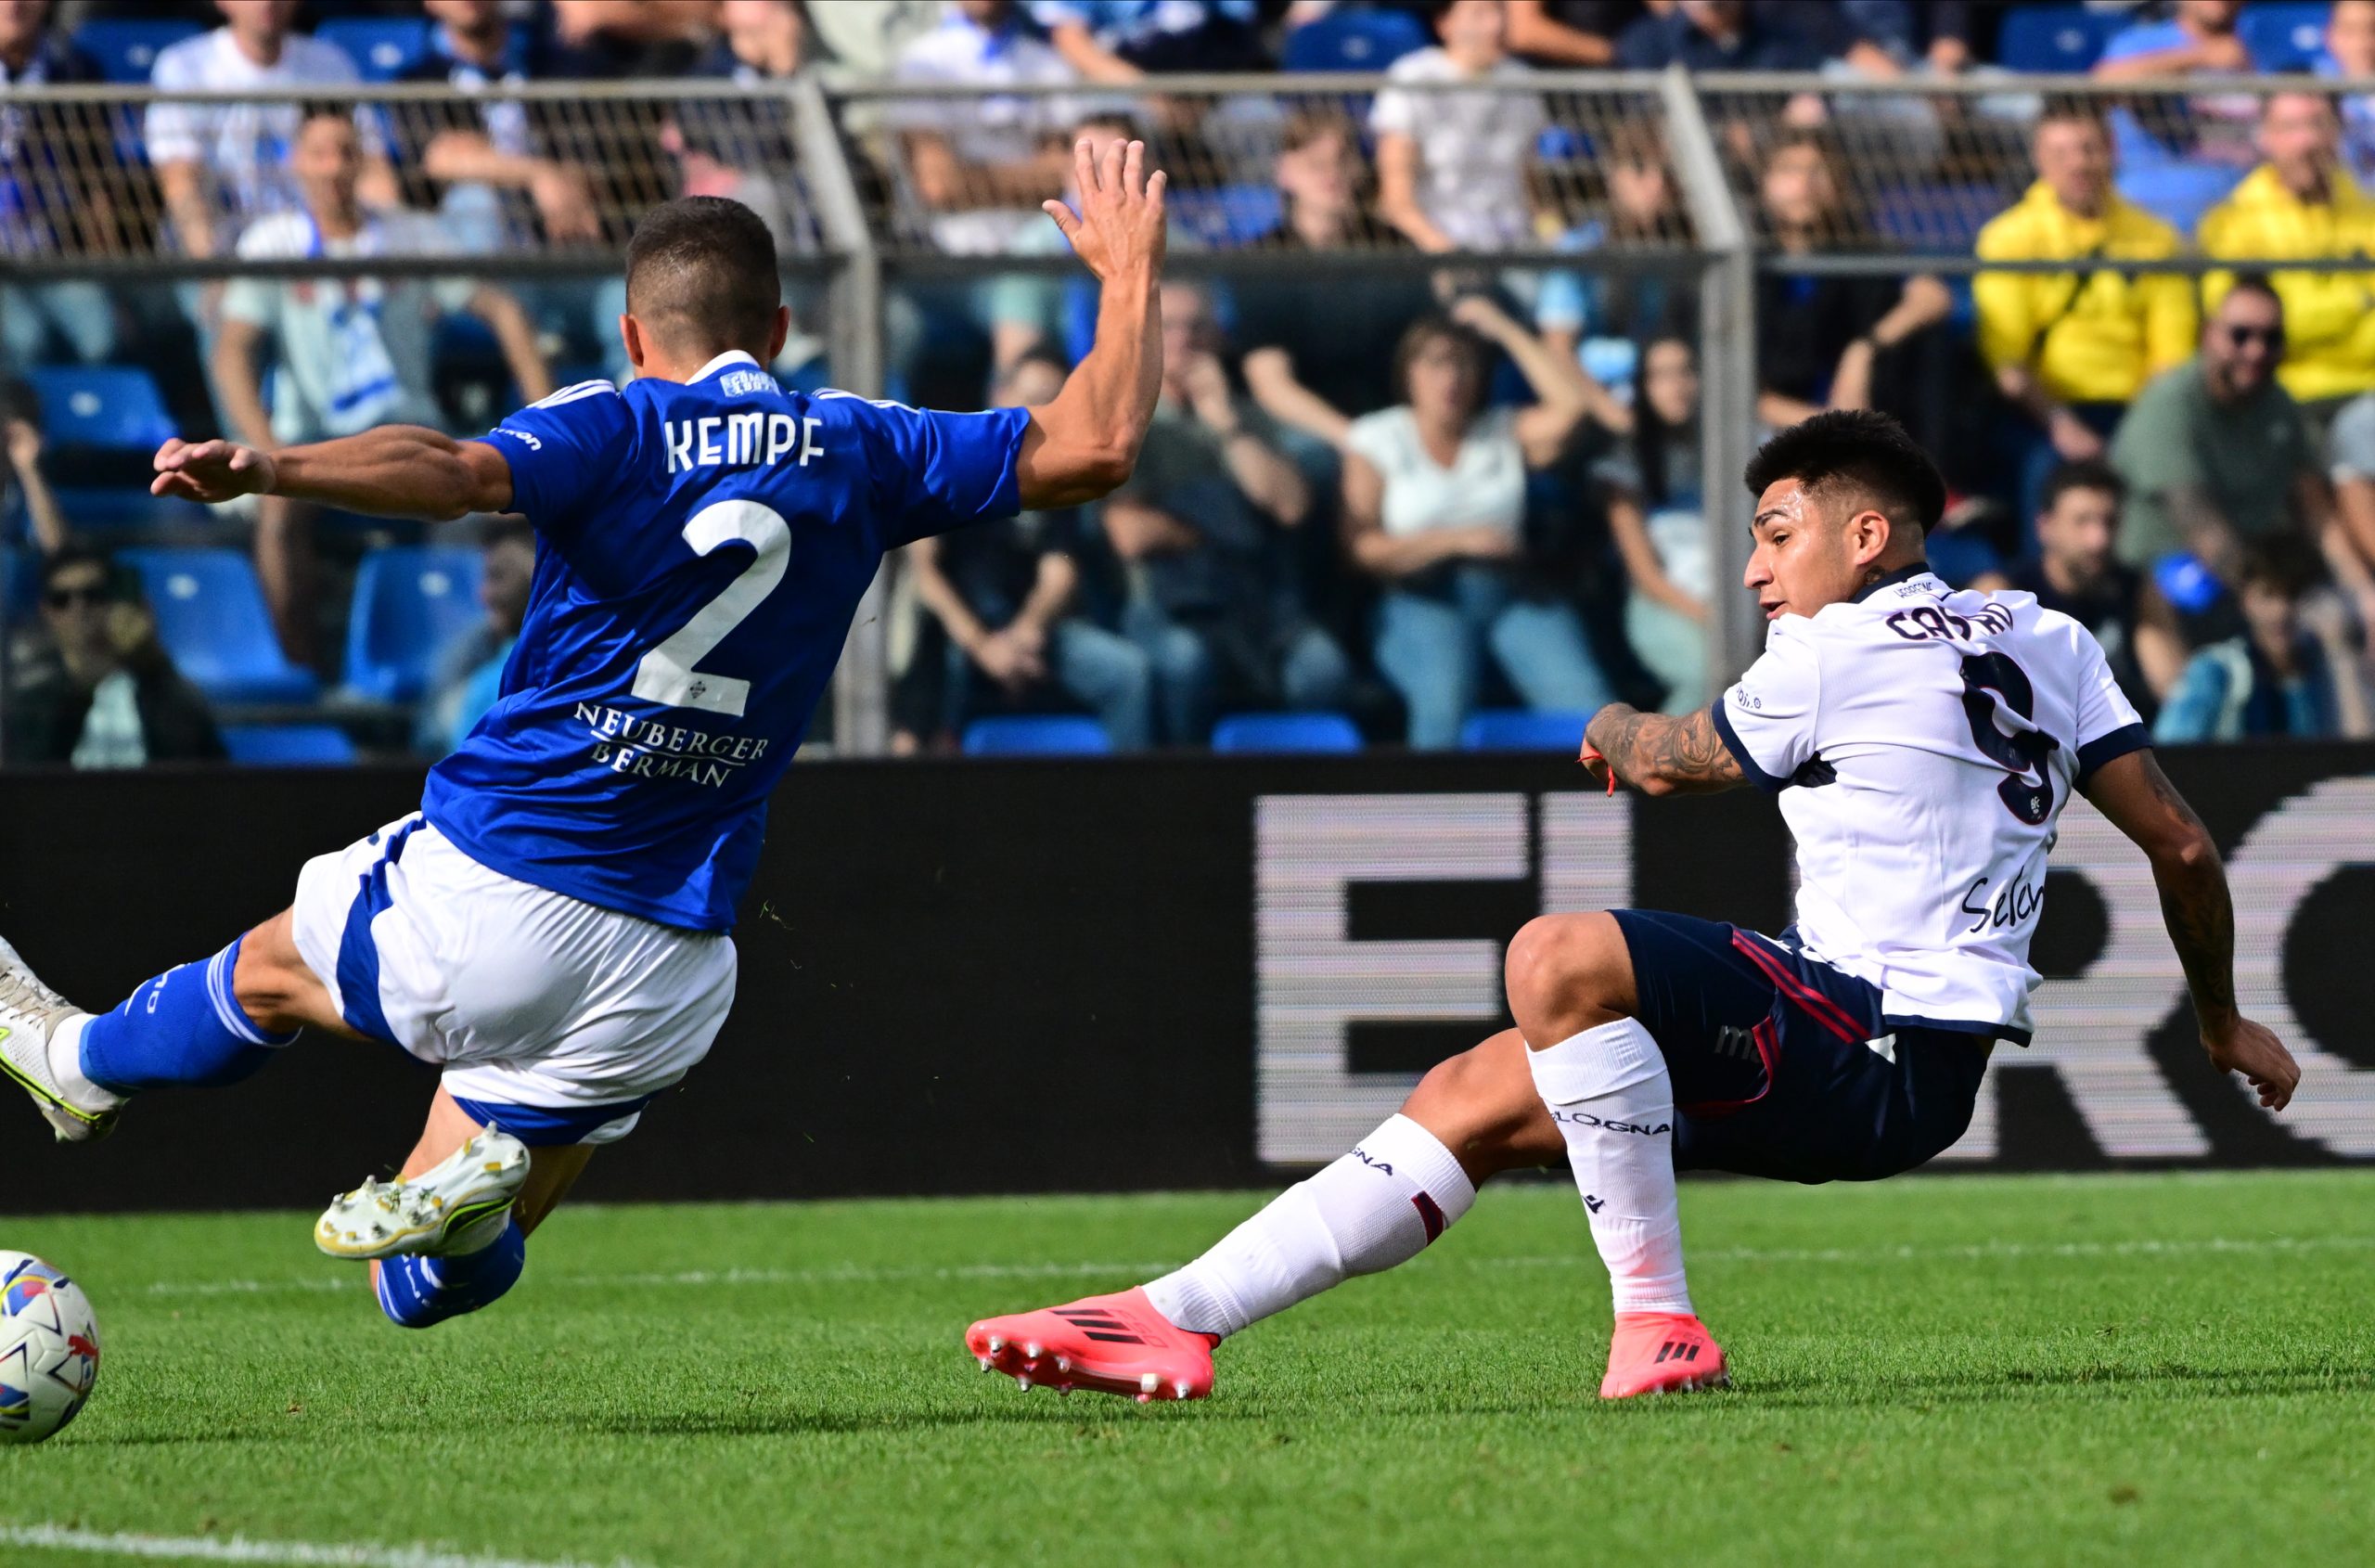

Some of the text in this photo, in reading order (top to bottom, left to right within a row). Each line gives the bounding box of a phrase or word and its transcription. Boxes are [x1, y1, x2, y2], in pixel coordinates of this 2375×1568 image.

[664, 412, 824, 473] KEMPF
[631, 499, 792, 717] 2
[573, 701, 768, 761] NEUBERGER
[1959, 650, 2060, 826] 9
[591, 742, 732, 788] BERMAN
